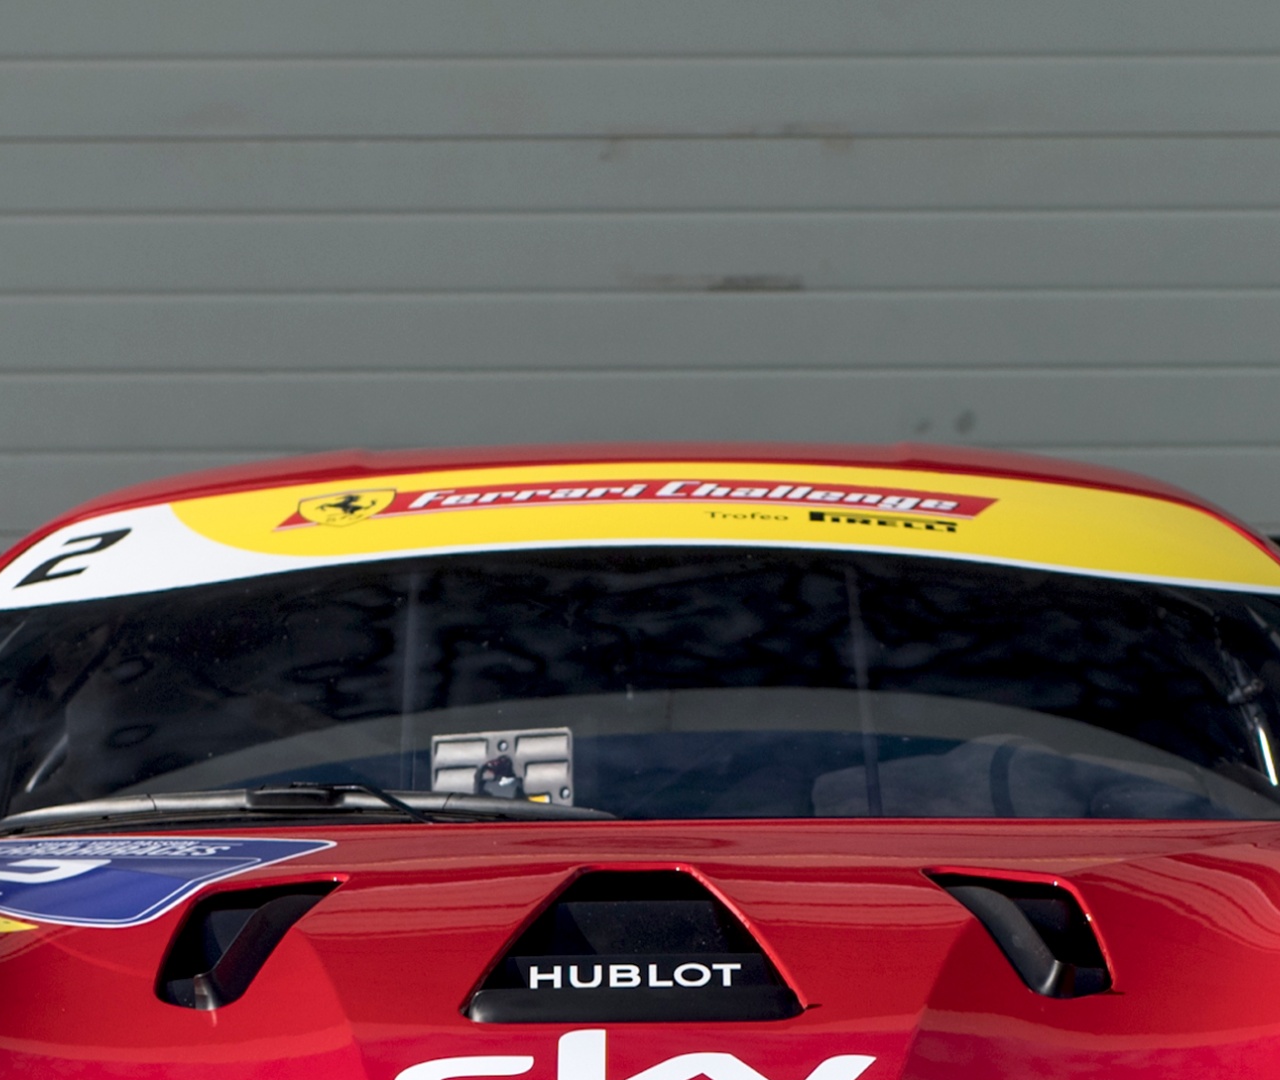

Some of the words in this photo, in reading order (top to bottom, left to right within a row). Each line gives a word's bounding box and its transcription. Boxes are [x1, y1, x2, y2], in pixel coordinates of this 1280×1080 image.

[408, 483, 648, 510] Ferrari
[655, 480, 959, 511] Challenge
[705, 511, 788, 521] Trofeo
[809, 510, 958, 533] PIRELLI
[13, 527, 132, 589] 2
[529, 963, 741, 989] HUBLOT
